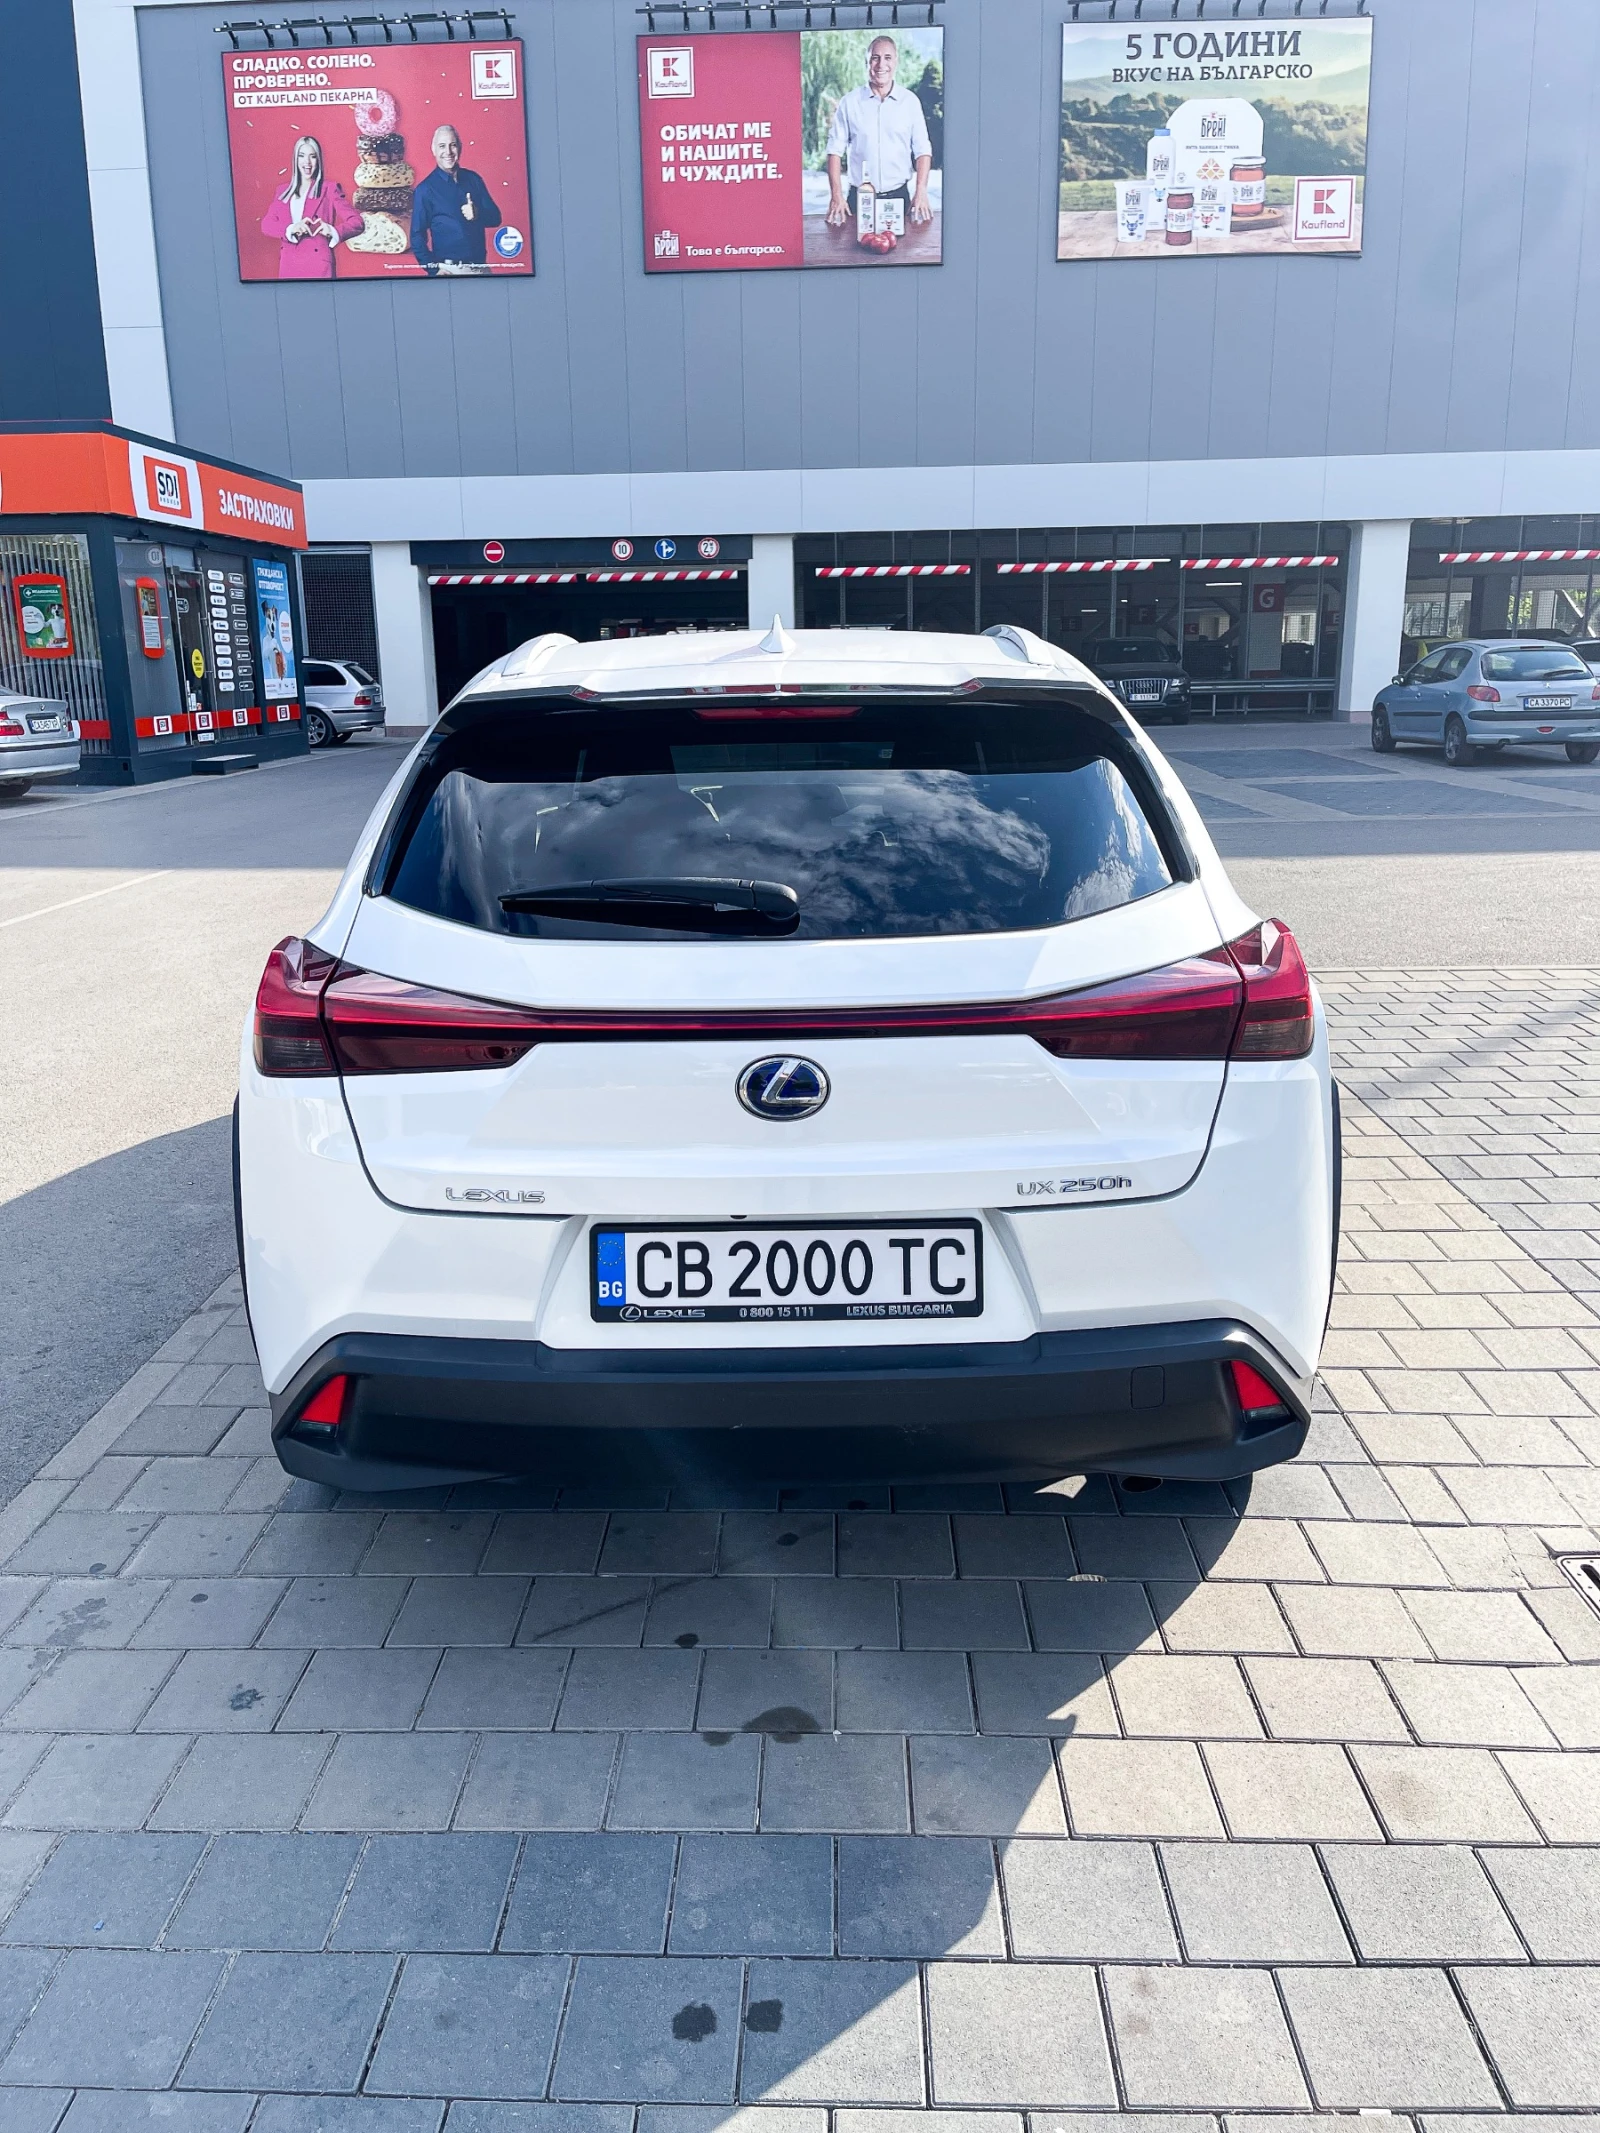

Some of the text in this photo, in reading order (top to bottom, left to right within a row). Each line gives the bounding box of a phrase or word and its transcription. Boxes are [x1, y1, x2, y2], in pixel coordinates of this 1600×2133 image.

[1126, 30, 1302, 63] 5 ГОДИНИ
[232, 54, 376, 73] СЛАДКО. СОЛЕНО.
[233, 73, 332, 89] ПРОВЕРЕНО.
[1112, 64, 1313, 83] ВКУС НА БЪЛГАРСКО
[478, 82, 510, 90] Kaufland
[655, 80, 688, 88] Kaufland
[238, 91, 374, 105] ОТ KAUFLAND ПЕКАРНА
[660, 122, 772, 141] ОБИЧАТ МЕ
[1201, 117, 1226, 138] Брей!
[661, 143, 769, 162] И НАШИТЕ,
[661, 163, 783, 184] И ЧУЖДИТЕ.
[1301, 219, 1345, 229] Kaufland
[685, 244, 785, 256] Това е българско.
[157, 471, 178, 499] SDI
[218, 489, 295, 531] ЗАСТРАХОВКИ
[618, 544, 628, 555] 10
[703, 543, 709, 553] 2
[1259, 589, 1275, 608] G
[1530, 698, 1570, 707] CA 3370 PC
[446, 1187, 545, 1203] LEXUS
[1017, 1175, 1132, 1196] UX 250h
[598, 1238, 966, 1298] BG CB 2000 TC
[644, 1304, 955, 1318] LEXUS 0 800 15 111 LEXUS BULGARIA
